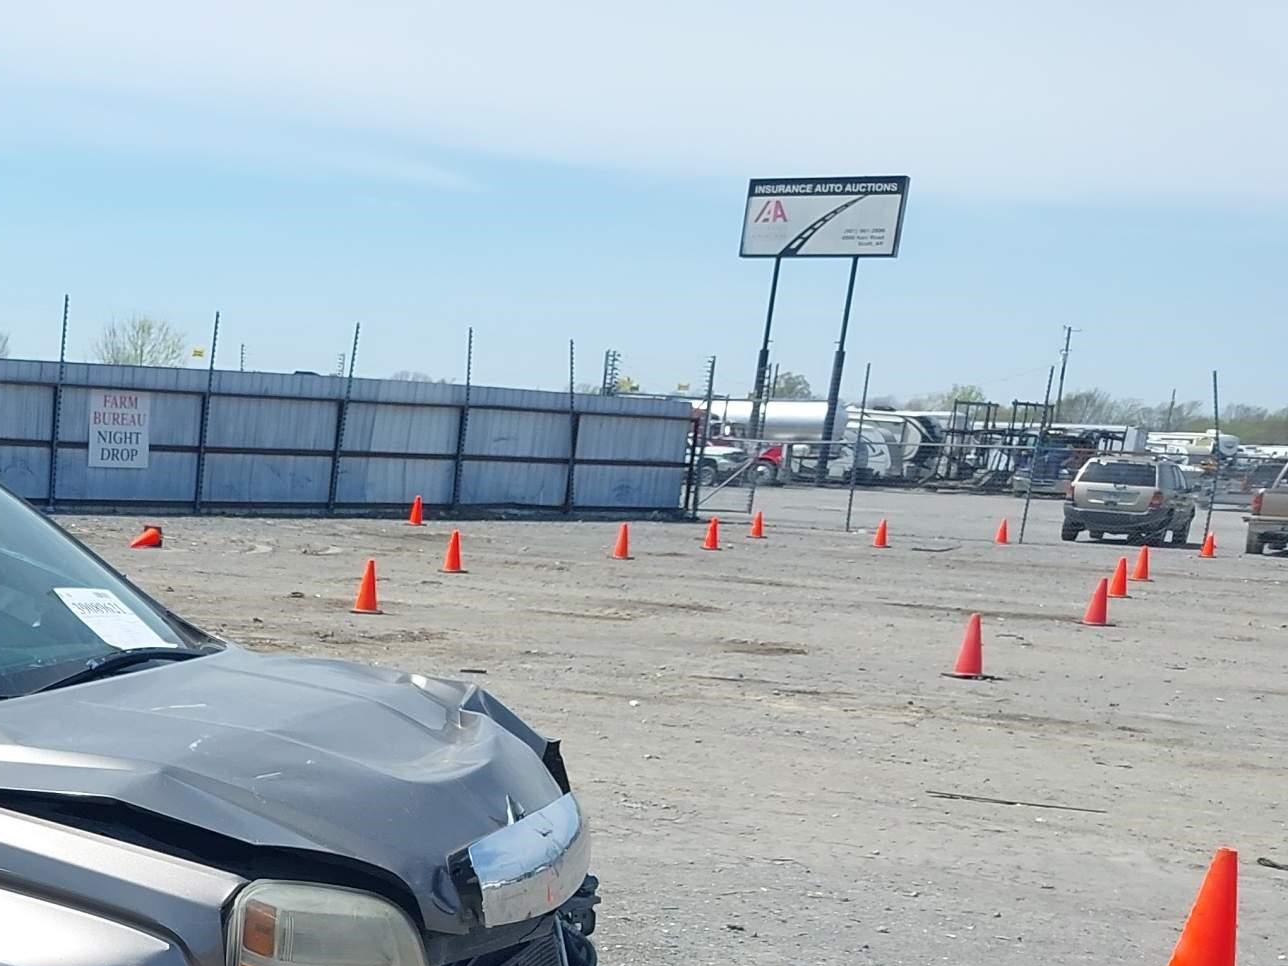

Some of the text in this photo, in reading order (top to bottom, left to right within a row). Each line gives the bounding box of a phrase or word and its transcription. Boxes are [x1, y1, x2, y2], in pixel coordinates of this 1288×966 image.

[754, 182, 898, 194] INSURANCE AUTO AUCTIONS
[103, 394, 138, 409] FARM
[93, 411, 147, 426] BUREAU
[97, 430, 142, 445] NIGHT
[100, 447, 138, 461] DROP
